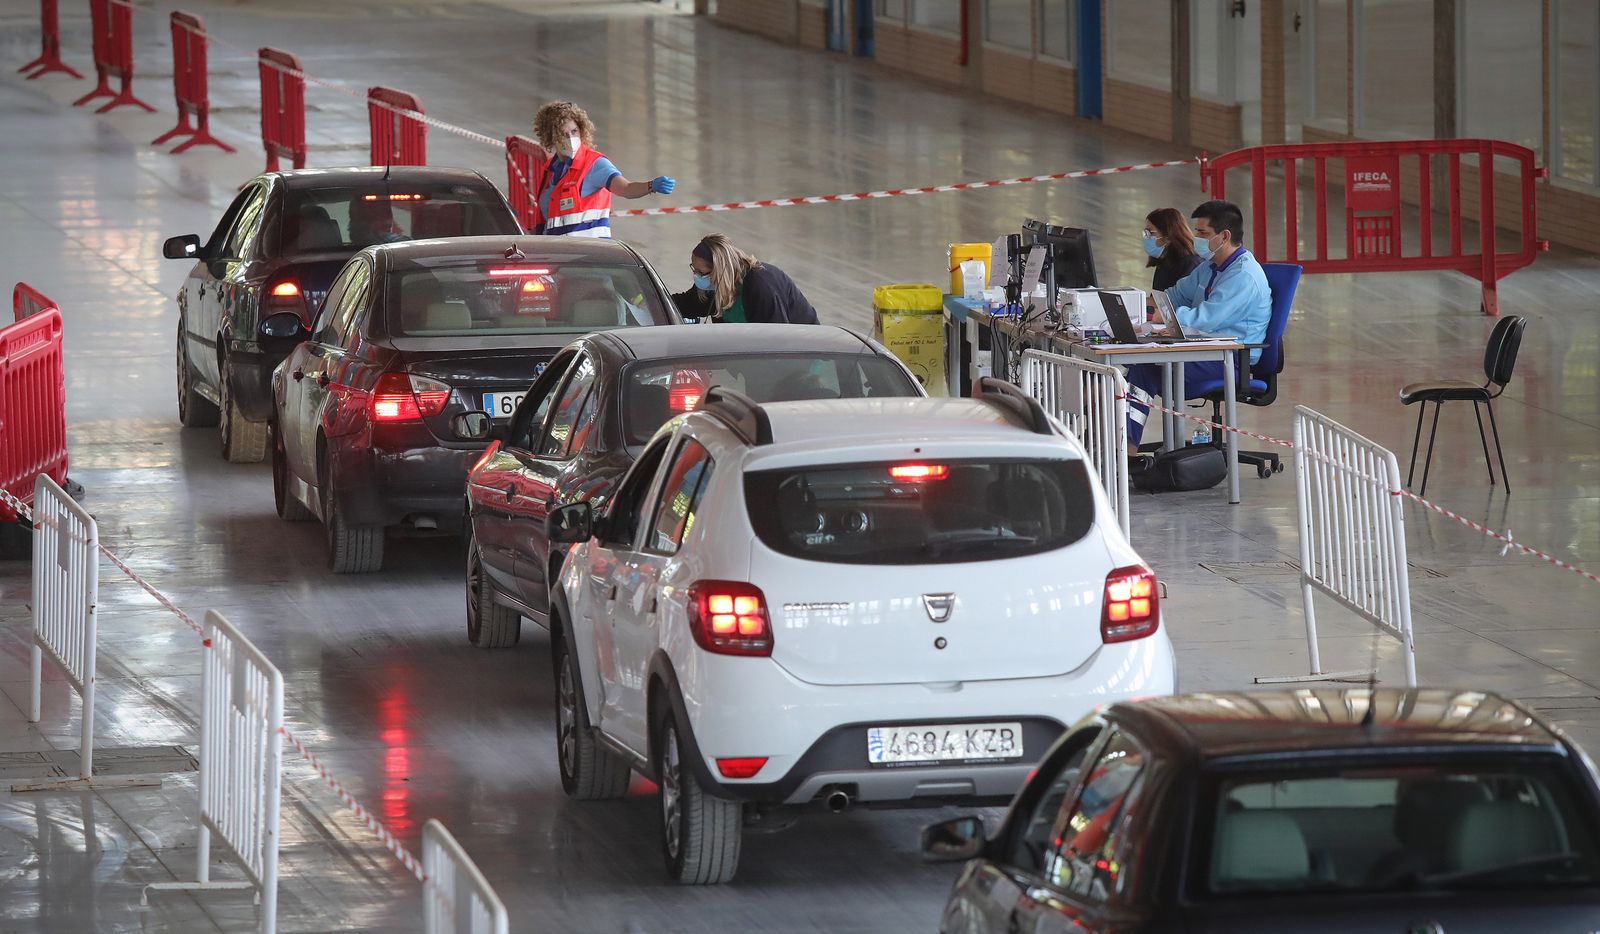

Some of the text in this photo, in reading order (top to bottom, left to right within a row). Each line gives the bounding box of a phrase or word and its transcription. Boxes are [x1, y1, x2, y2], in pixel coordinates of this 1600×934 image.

[1353, 172, 1388, 181] IFECA
[889, 728, 1014, 756] 4684 KZB
